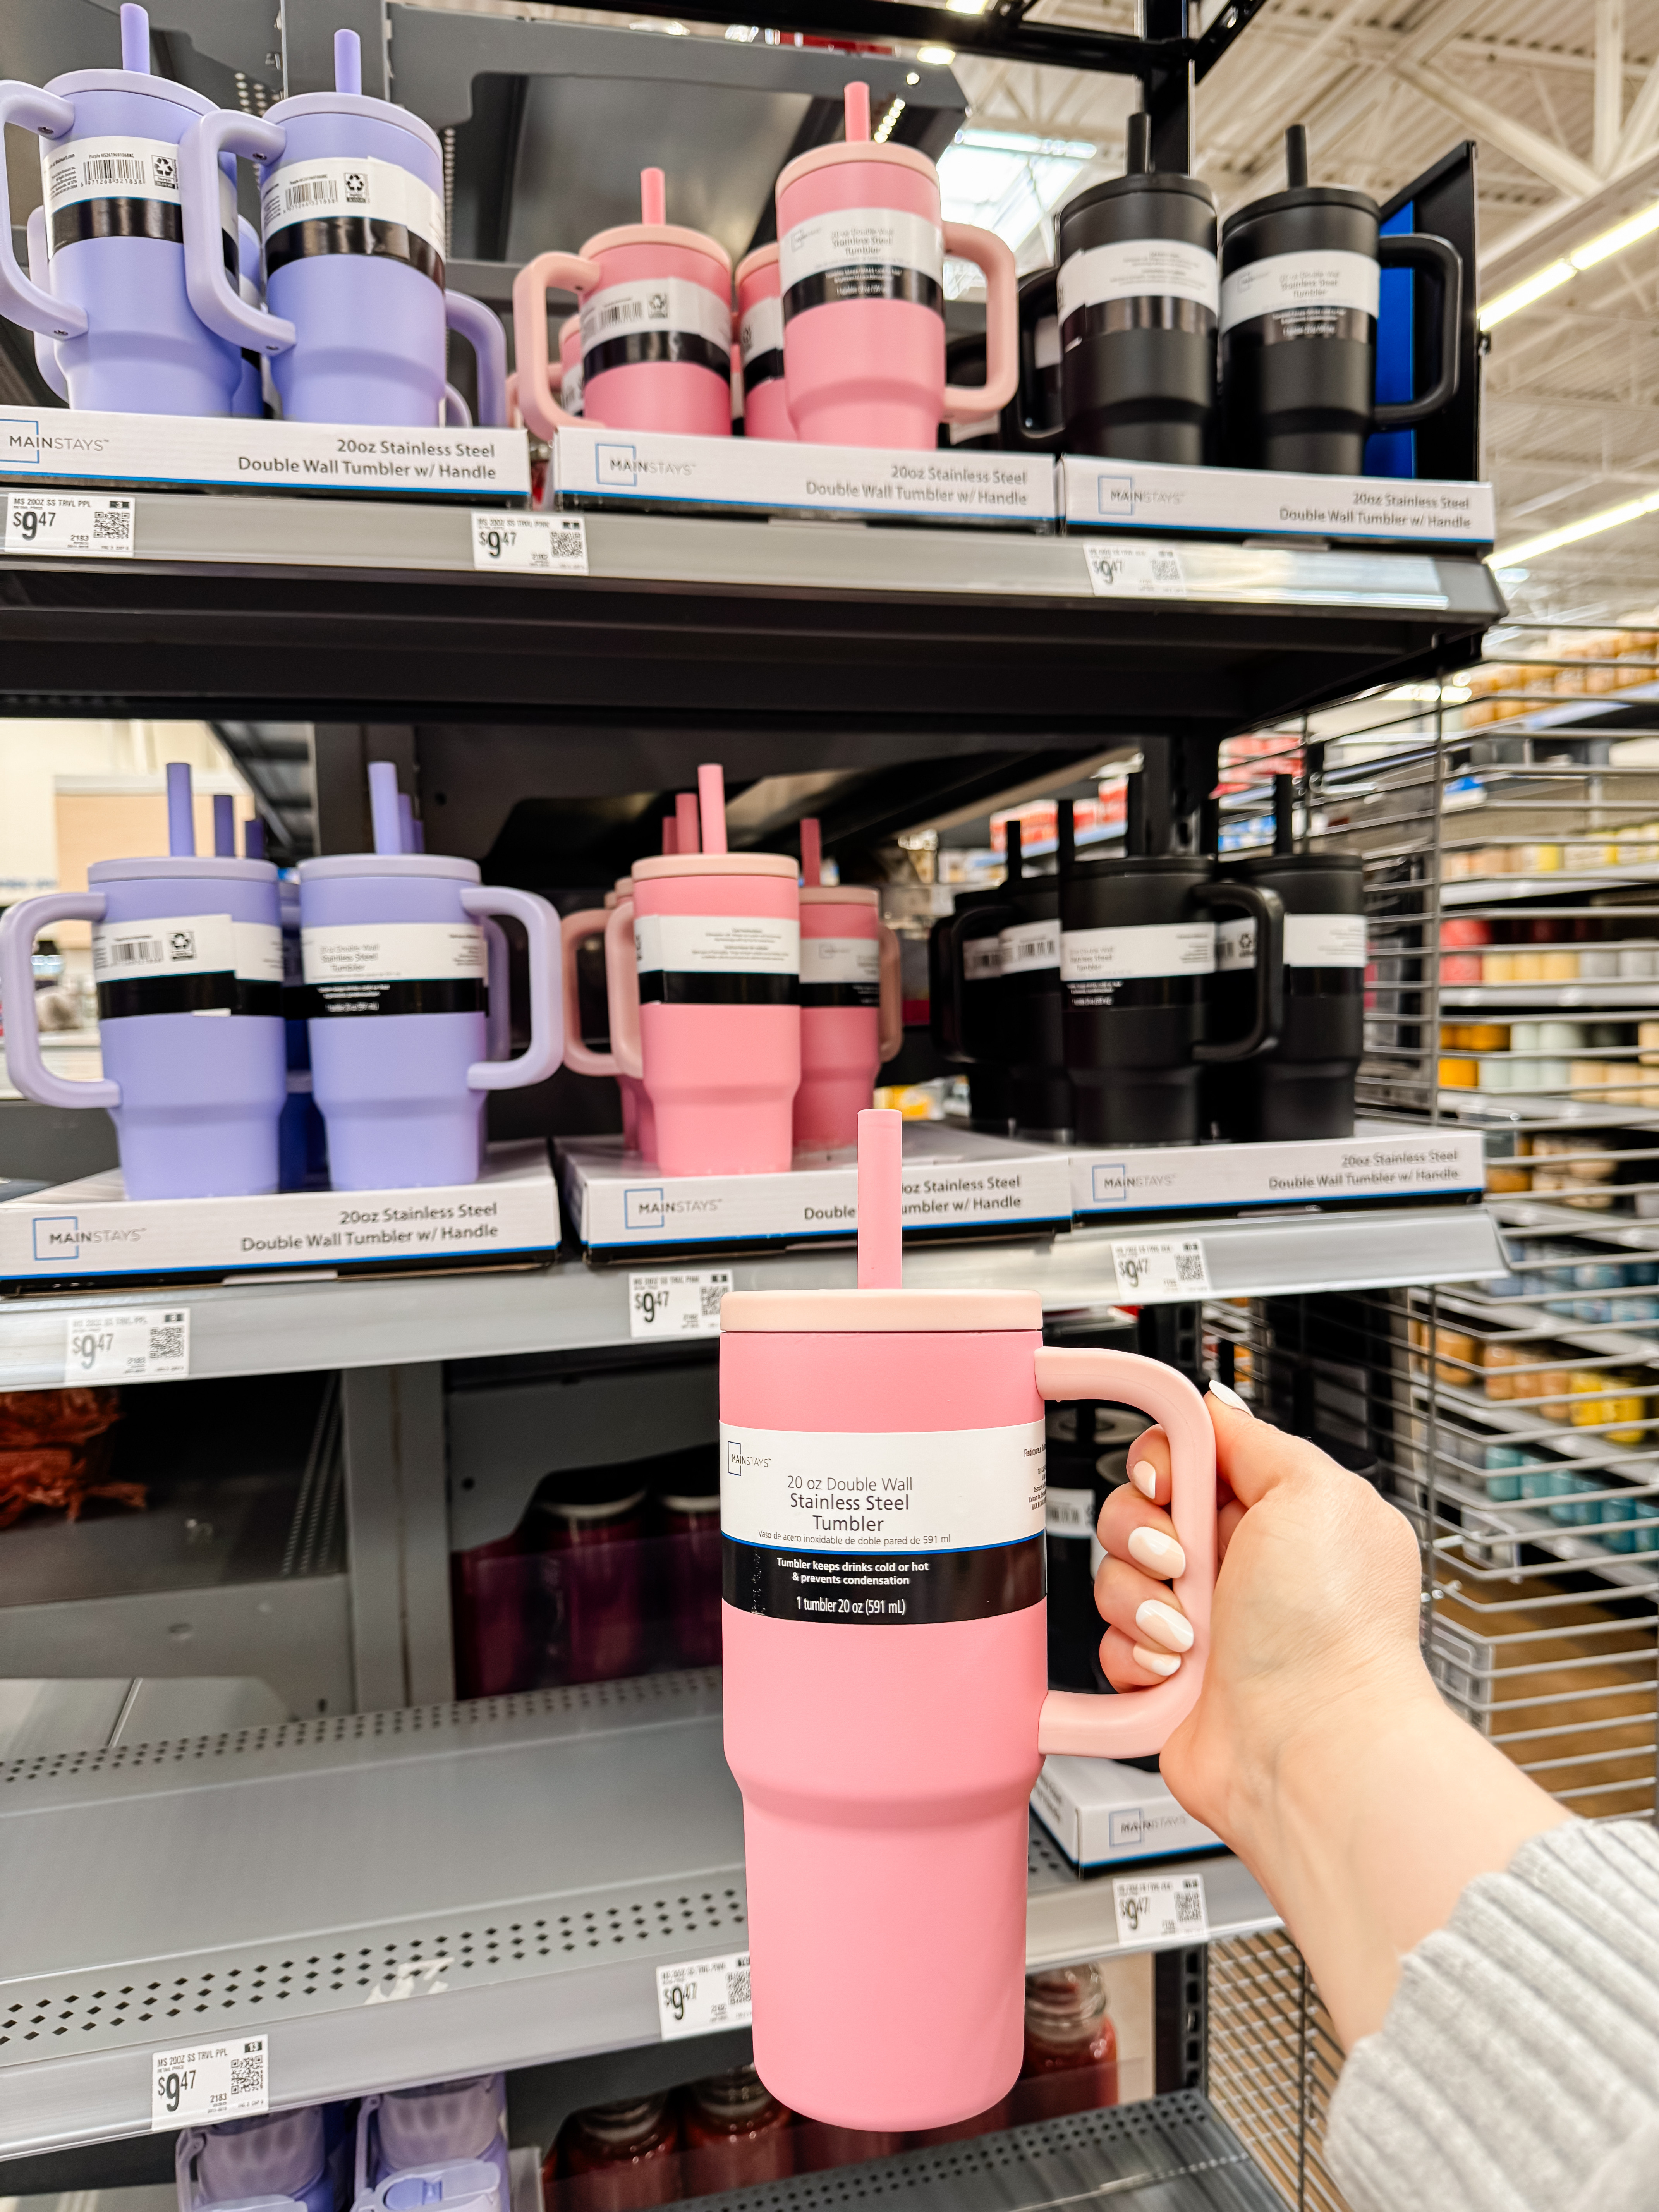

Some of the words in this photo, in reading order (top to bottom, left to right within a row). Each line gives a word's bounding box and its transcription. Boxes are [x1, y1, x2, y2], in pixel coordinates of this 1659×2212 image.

[336, 439, 375, 453] 20oz
[380, 441, 451, 456] Stainless
[455, 443, 495, 458] Steel
[238, 457, 300, 472] Double
[303, 459, 338, 474] Wall
[343, 461, 410, 476] Tumbler
[414, 465, 434, 478] w/
[439, 465, 496, 479] Handle
[891, 465, 925, 480] 20oz
[928, 467, 988, 483] Stainless
[992, 470, 1027, 485] Steel
[806, 481, 859, 497] Double
[862, 483, 891, 499] Wall
[896, 486, 953, 503] Tumbler
[957, 489, 975, 504] w/
[978, 489, 1027, 505] Handle
[1353, 492, 1382, 504] 20oz
[1384, 494, 1437, 508] Stainless
[1440, 496, 1469, 509] Steel
[1279, 508, 1324, 522] Double
[1328, 509, 1353, 523] Wall
[1358, 512, 1406, 526] Tumbler
[1428, 514, 1471, 529] Handle
[1373, 1151, 1425, 1165] Stainless
[1428, 1148, 1458, 1161] Steel
[902, 1182, 920, 1194] oz
[924, 1178, 983, 1193] Stainless
[988, 1175, 1022, 1188] Steel
[1269, 1175, 1314, 1190] Double
[1317, 1173, 1343, 1186] Wall
[1346, 1171, 1394, 1185] Tumbler
[1416, 1168, 1460, 1181] Handle
[340, 1210, 378, 1224] 20oz
[383, 1205, 454, 1222] Stainless
[457, 1202, 498, 1217] Steel
[804, 1205, 856, 1220] Double
[902, 1200, 948, 1214] umbler
[953, 1198, 969, 1212] w/
[973, 1195, 1021, 1210] Handle
[241, 1235, 302, 1251] Double
[306, 1232, 341, 1247] Wall
[346, 1229, 413, 1246] Tumbler
[417, 1227, 438, 1242] w/
[441, 1223, 499, 1240] Handle
[787, 1475, 802, 1489] 20
[807, 1479, 822, 1490] oz
[827, 1477, 877, 1491] Double
[881, 1477, 912, 1491] Wall
[790, 1493, 860, 1510] Stainless
[866, 1494, 909, 1510] Steel
[812, 1515, 884, 1531] Tumbler
[758, 1530, 771, 1539] Vaso
[773, 1531, 781, 1540] de
[804, 1534, 843, 1544] inoxidable
[845, 1535, 855, 1544] de
[858, 1536, 881, 1545] doble
[884, 1536, 908, 1547] pared
[910, 1536, 921, 1544] de
[923, 1535, 938, 1544] 591
[941, 1534, 950, 1543] ml
[777, 1557, 811, 1570] Tumbler
[813, 1560, 840, 1572] keeps
[842, 1562, 872, 1572] drinks
[875, 1562, 895, 1572] cold
[912, 1562, 929, 1571] hot
[792, 1572, 799, 1581] &
[801, 1574, 841, 1585] prevents
[843, 1576, 910, 1585] condensation
[797, 1596, 801, 1609] 1
[804, 1597, 836, 1612] tumbler
[838, 1599, 850, 1613] 20
[852, 1602, 863, 1613] oz
[865, 1599, 885, 1616] (591
[888, 1599, 906, 1616] mL)
[157, 2058, 167, 2067] MS
[187, 2052, 196, 2062] SS
[215, 2048, 228, 2057] PPL
[210, 2092, 227, 2103] 2183
